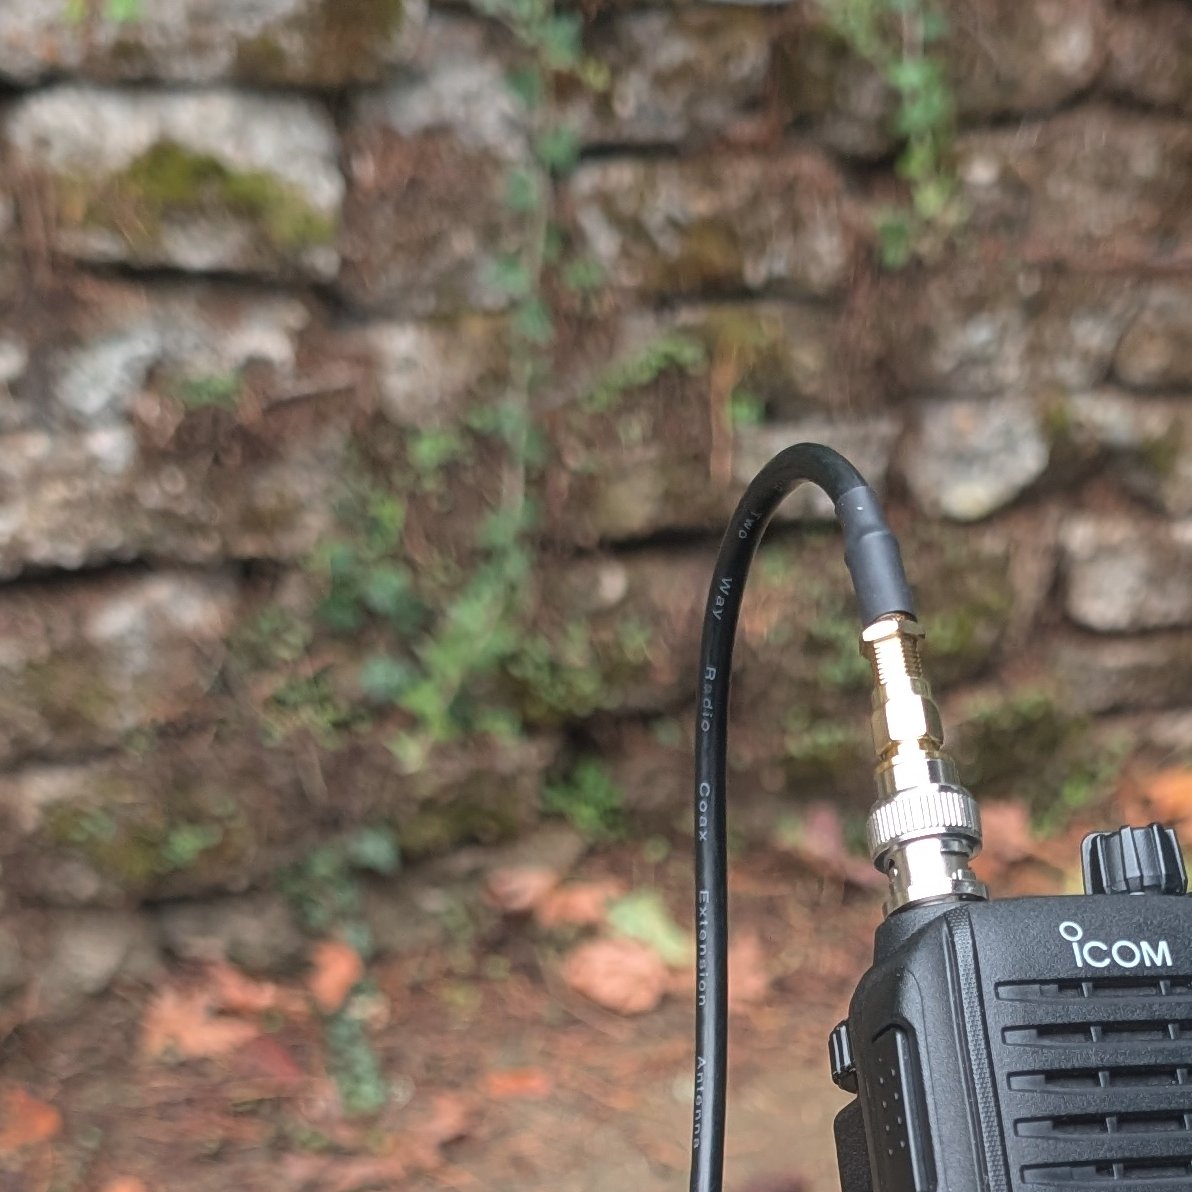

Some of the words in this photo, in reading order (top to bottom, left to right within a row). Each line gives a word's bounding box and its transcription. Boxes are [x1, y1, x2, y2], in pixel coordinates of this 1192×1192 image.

[738, 510, 763, 539] Two
[712, 577, 733, 620] Way
[700, 666, 717, 732] Radio
[699, 782, 711, 841] Coax
[698, 890, 710, 1006] Extension
[693, 1055, 707, 1149] Antenna
